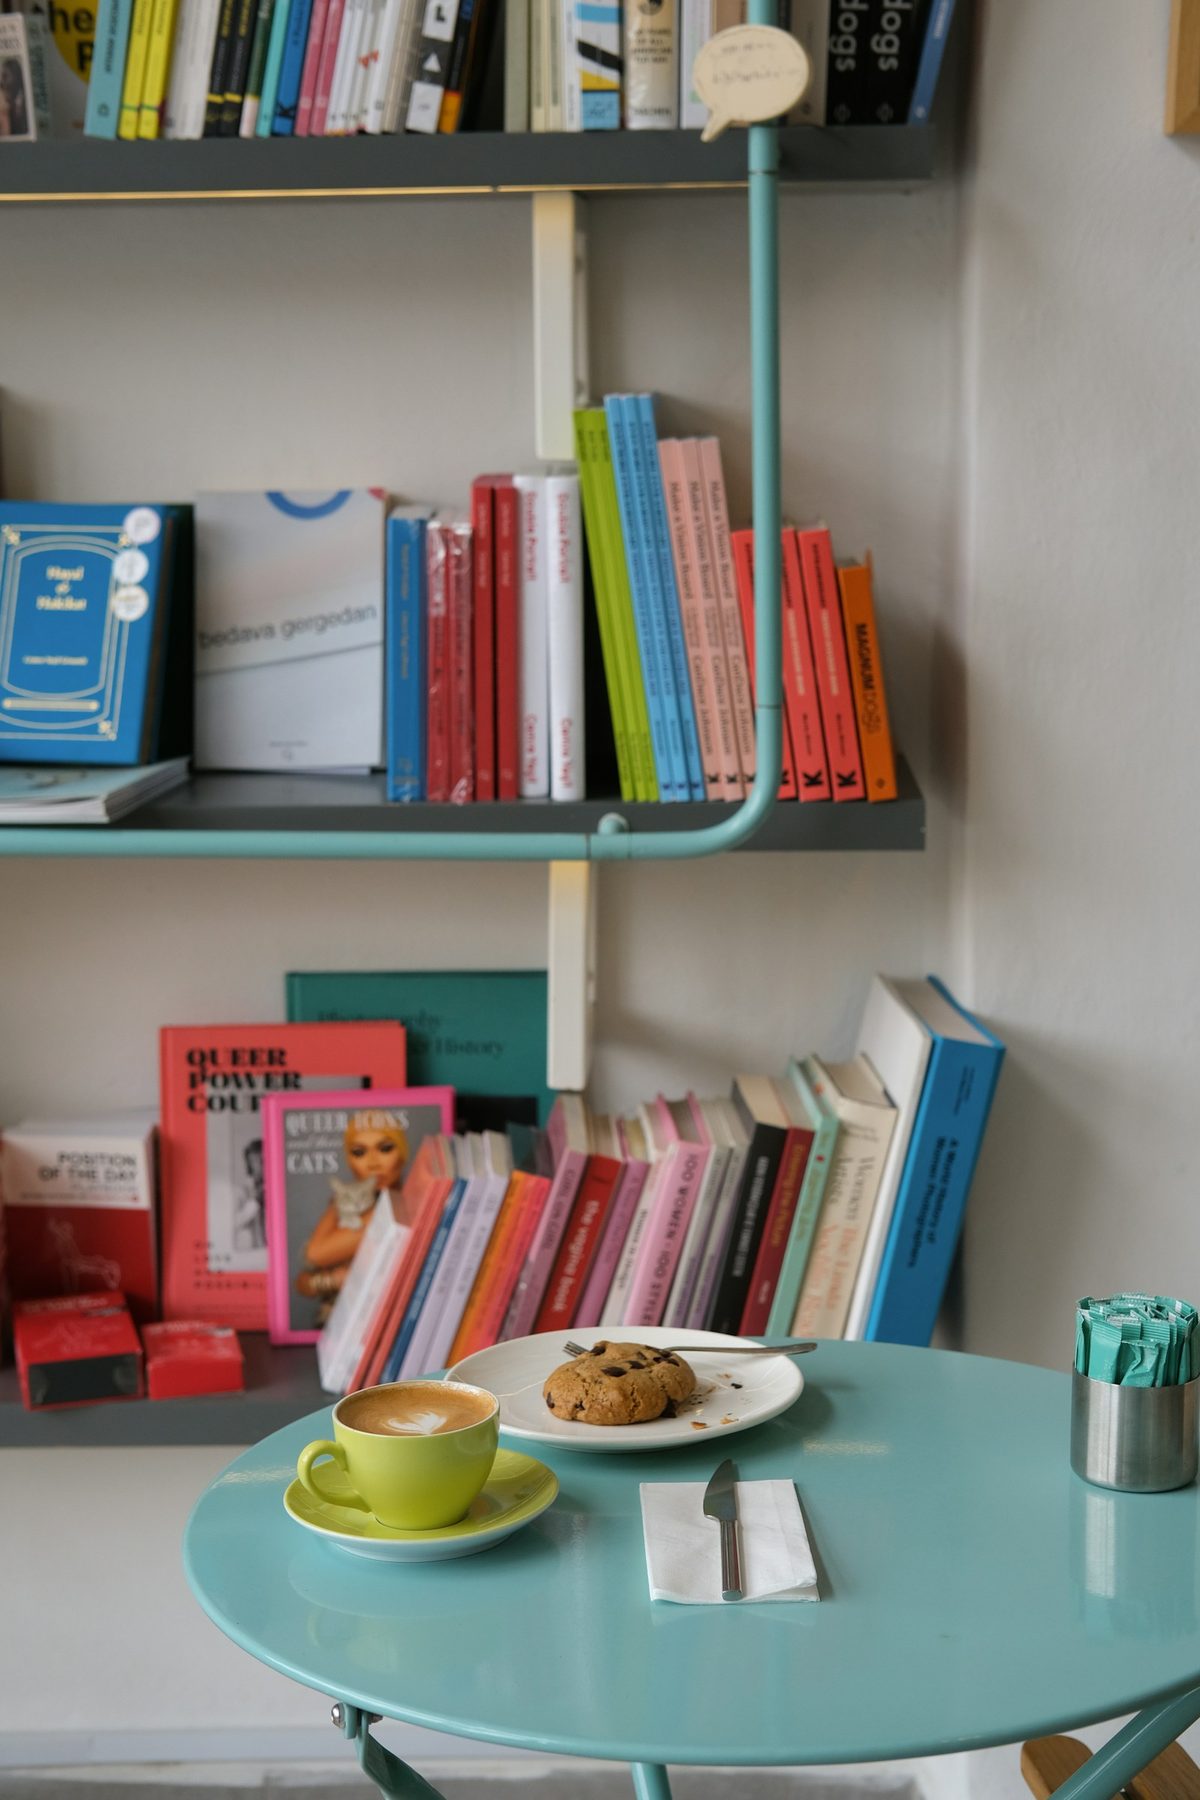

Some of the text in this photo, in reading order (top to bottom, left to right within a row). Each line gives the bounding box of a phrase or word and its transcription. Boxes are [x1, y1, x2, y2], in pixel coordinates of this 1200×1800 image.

[186, 1047, 288, 1070] QUEER
[188, 1070, 302, 1091] POWER
[285, 1110, 348, 1134] QUEER
[57, 1150, 138, 1168] POSITION
[286, 1151, 339, 1174] CATS
[38, 1165, 59, 1181] OF
[664, 1186, 690, 1241] WOMEN
[552, 1199, 600, 1312] the vagina book
